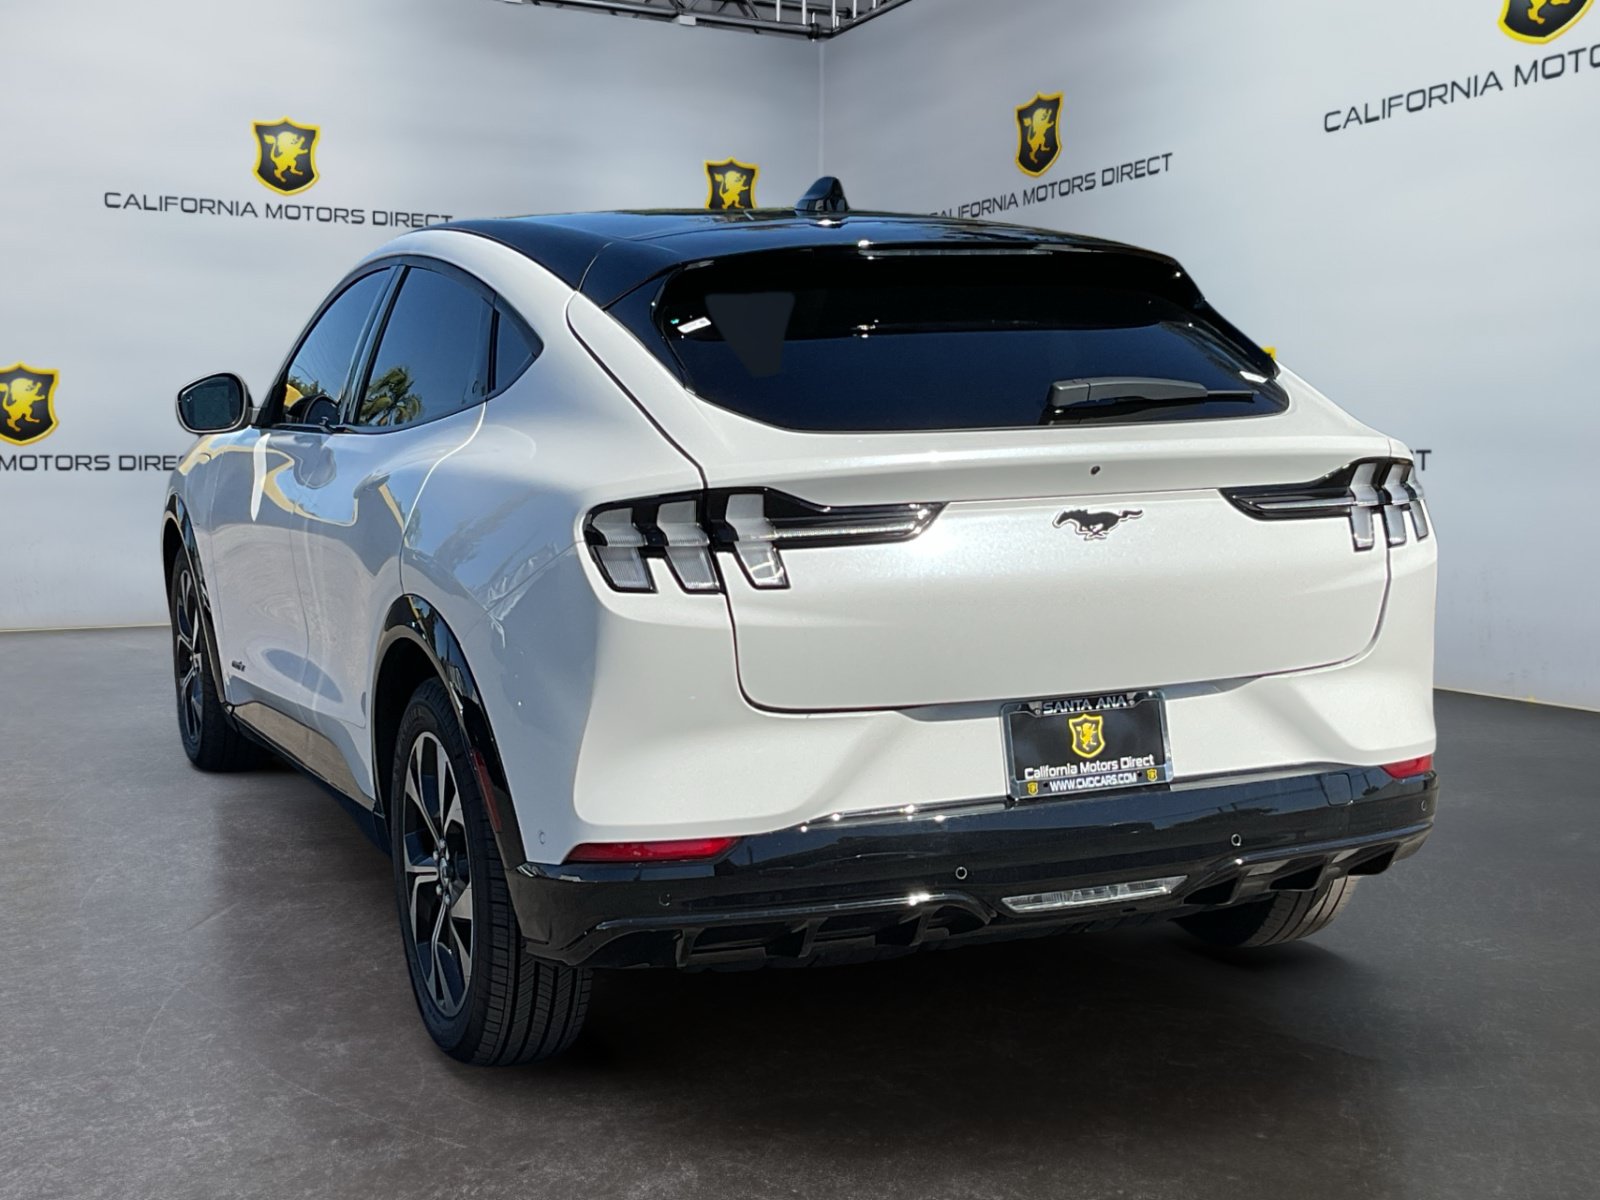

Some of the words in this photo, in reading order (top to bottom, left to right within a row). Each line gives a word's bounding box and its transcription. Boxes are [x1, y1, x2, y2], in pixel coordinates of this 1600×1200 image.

[1324, 70, 1503, 132] CALIFORNIA
[1022, 172, 1096, 206] MOTORS
[1101, 152, 1173, 187] DIRECT
[104, 192, 258, 218] CALIFORNIA
[265, 203, 365, 225] MOTORS
[0, 454, 110, 471] MOTORS
[118, 455, 184, 471] DIRE
[1043, 699, 1093, 714] SANTA
[1096, 695, 1127, 709] ANA
[1024, 763, 1078, 780] California
[1080, 760, 1119, 774] Motors
[1120, 754, 1155, 769] Direct
[1049, 772, 1137, 792] WWW.CMDCARS.COM
